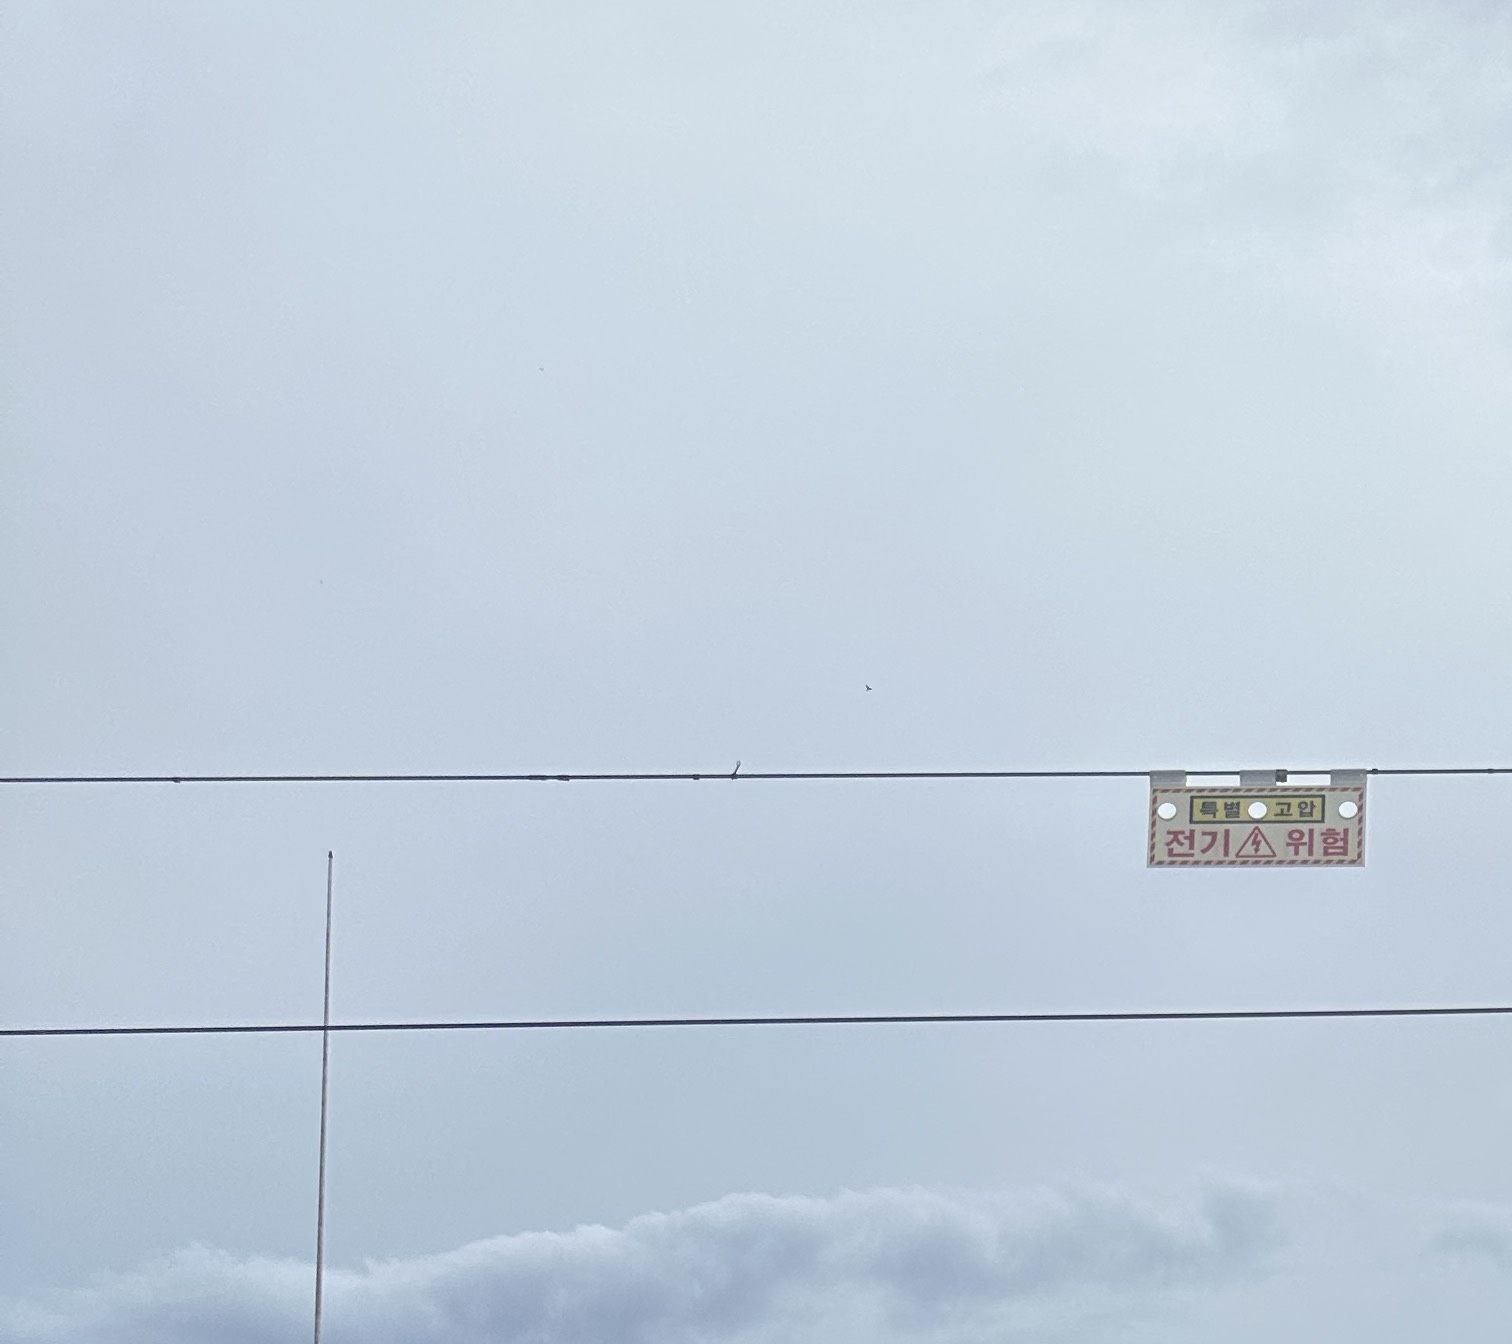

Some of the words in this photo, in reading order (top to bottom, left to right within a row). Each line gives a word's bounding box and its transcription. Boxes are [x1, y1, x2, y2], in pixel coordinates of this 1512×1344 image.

[1200, 801, 1241, 819] 특별
[1274, 800, 1315, 818] 고압
[1165, 829, 1230, 857] 전기
[1285, 828, 1349, 857] 위험
